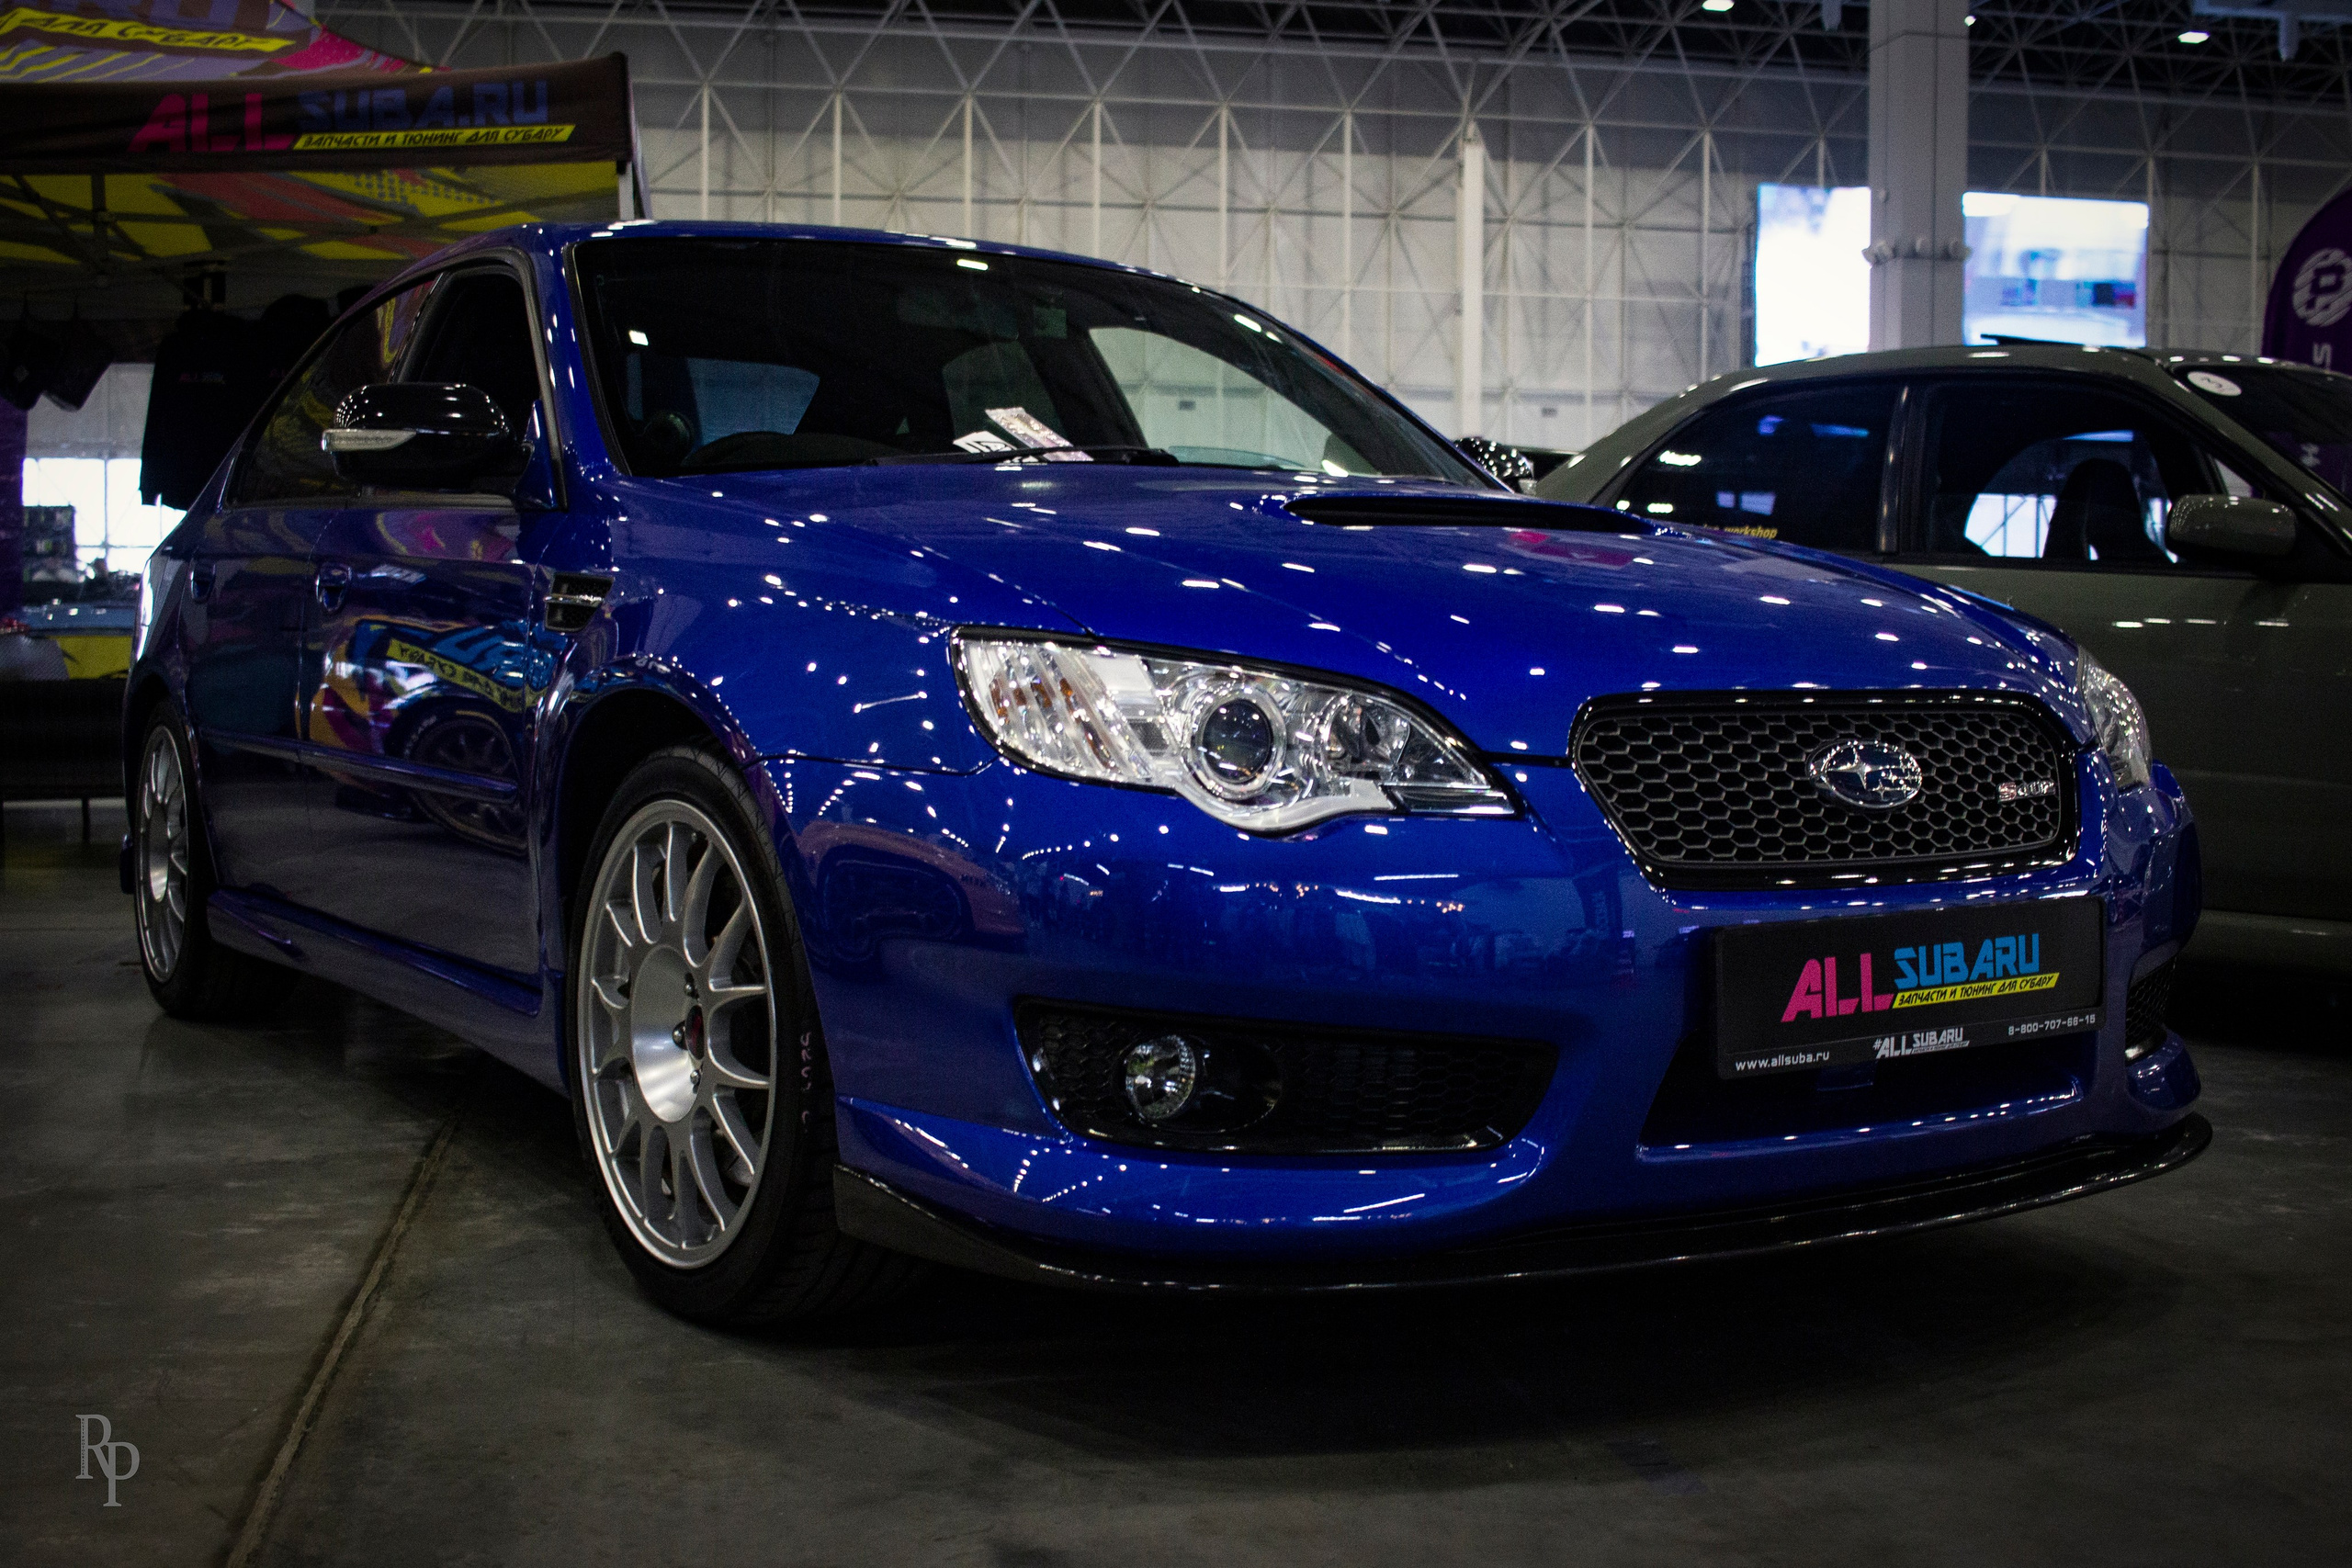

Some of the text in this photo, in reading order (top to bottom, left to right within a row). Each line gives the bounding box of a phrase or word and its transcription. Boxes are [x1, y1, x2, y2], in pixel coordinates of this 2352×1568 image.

[126, 81, 548, 152] ALL SUBA.RU
[303, 128, 564, 148] ЗАПЧАСТИ И ТЮНИНГ ДЛЯ СУБАРУ
[1781, 932, 2040, 1022] ALL SUBARU
[1899, 975, 2054, 1006] ЗАПЧАСТИ И ТЮНИНГ ДЛЯ СУБАРУ
[2007, 1013, 2096, 1036] 8-800-707-66-15
[1872, 1035, 1912, 1059] #ALL
[1912, 1027, 1964, 1047] SUBARU
[1736, 1051, 1830, 1071] www.allsuba.ru
